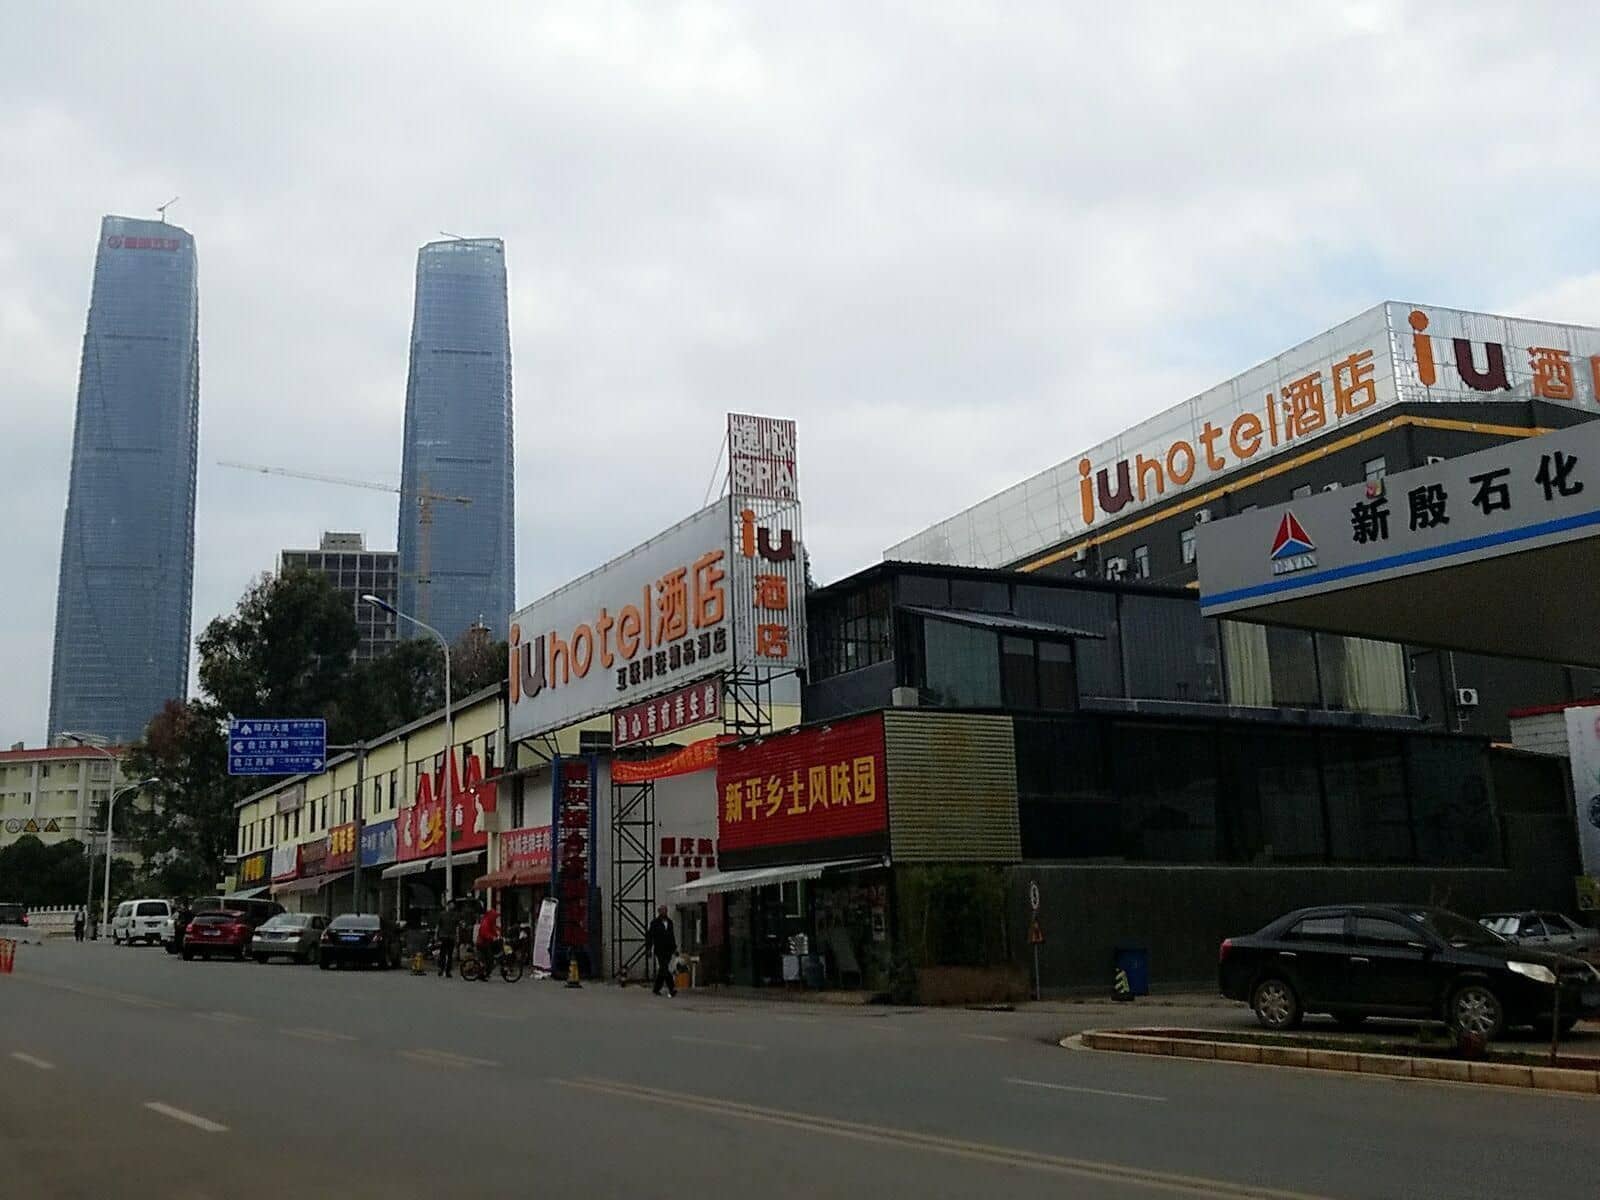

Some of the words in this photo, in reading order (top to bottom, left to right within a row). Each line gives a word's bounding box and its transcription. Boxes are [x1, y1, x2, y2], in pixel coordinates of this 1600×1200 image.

[1408, 310, 1512, 392] iu
[1527, 346, 1600, 402] 酒
[740, 508, 796, 563] iu
[752, 574, 789, 658] 酒店
[725, 755, 876, 824] 新平乡土风味园
